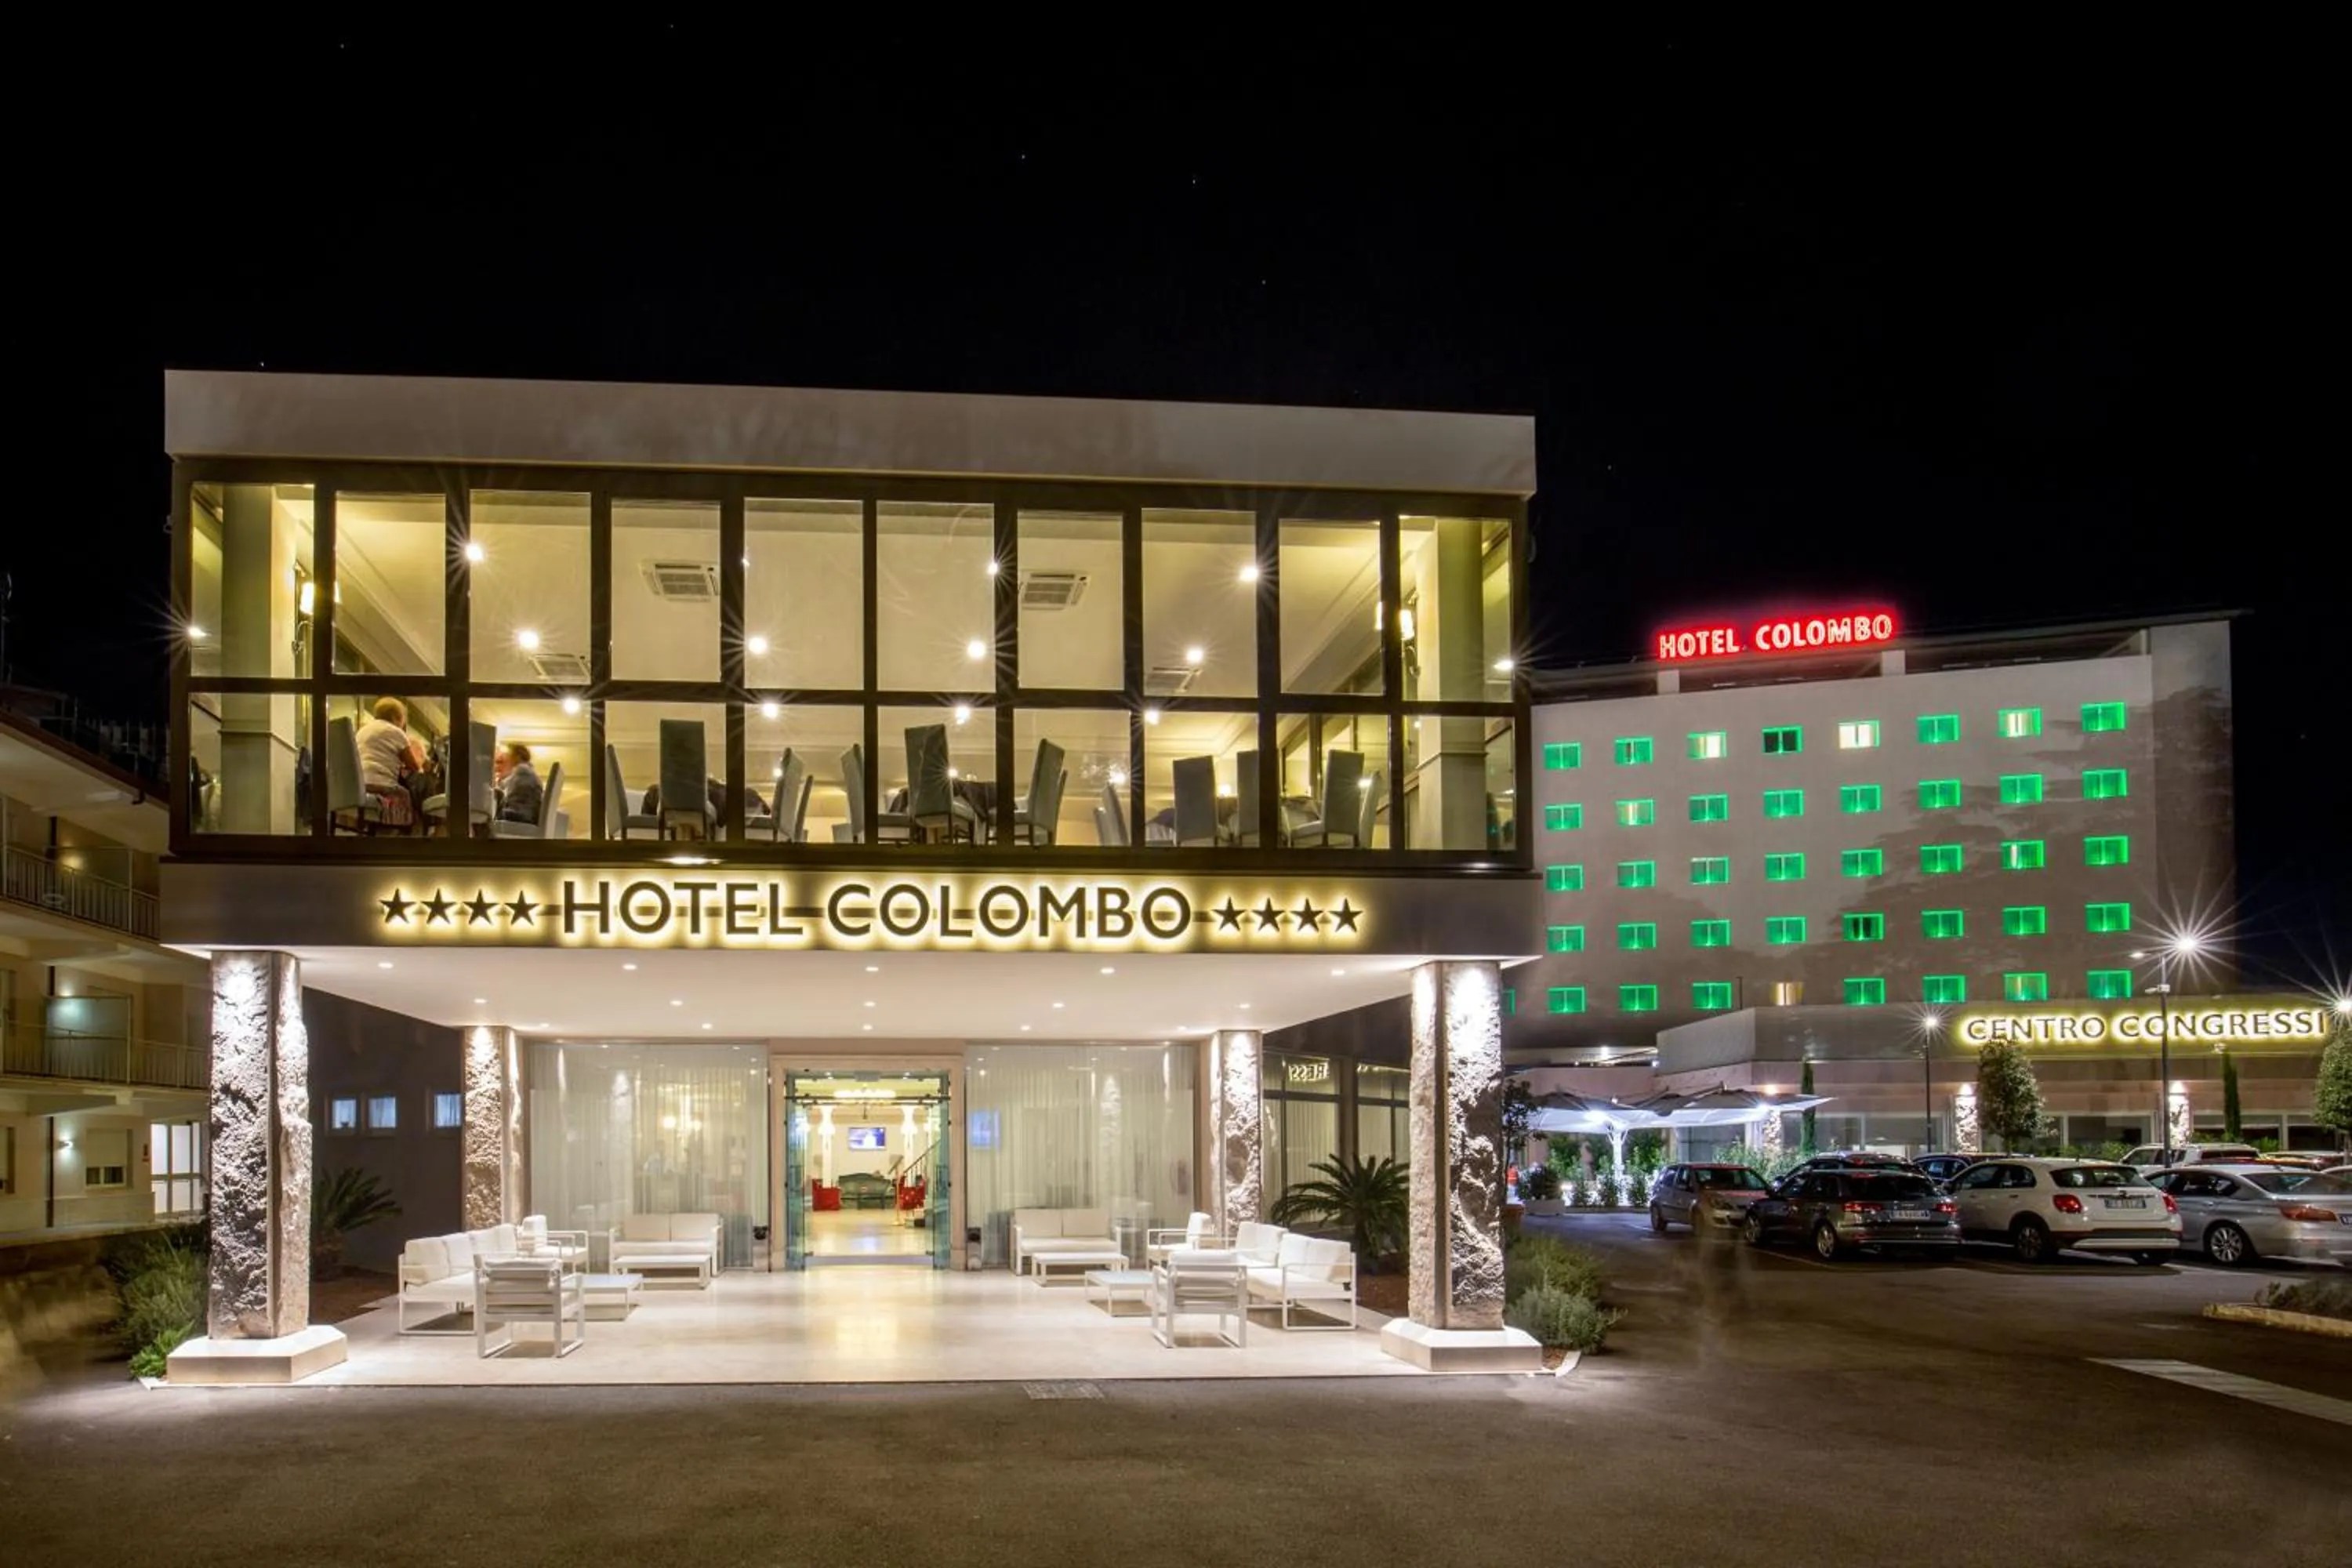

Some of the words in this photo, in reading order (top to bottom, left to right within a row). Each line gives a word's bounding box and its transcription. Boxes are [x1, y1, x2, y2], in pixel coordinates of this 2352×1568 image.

[1659, 629, 1739, 659] HOTEL
[1755, 615, 1892, 650] COLOMBO
[564, 880, 803, 935] HOTEL
[828, 884, 1191, 938] COLOMBO
[1967, 1017, 2105, 1040] CENTRO
[2119, 1011, 2324, 1036] CONGRESSI
